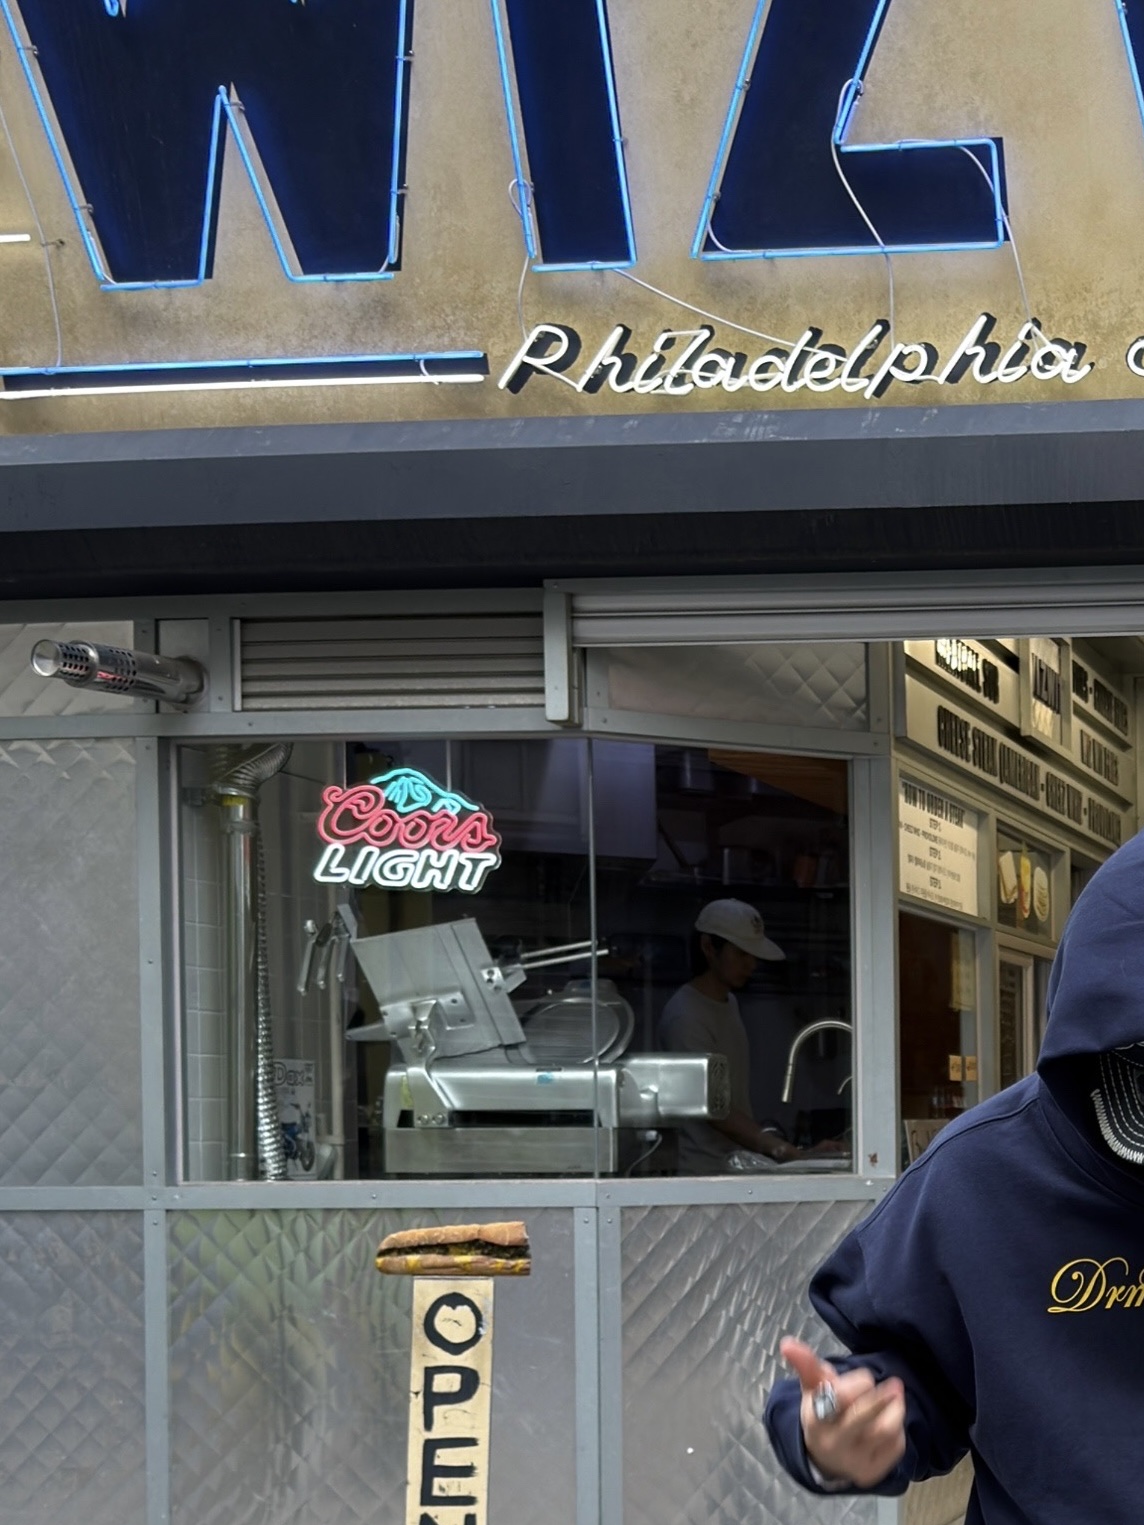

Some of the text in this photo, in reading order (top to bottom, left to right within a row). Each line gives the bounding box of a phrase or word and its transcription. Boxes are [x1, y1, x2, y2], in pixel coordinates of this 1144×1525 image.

[498, 311, 1096, 399] Philadelphia
[317, 784, 497, 853] Coors
[314, 843, 497, 891] LIGHT
